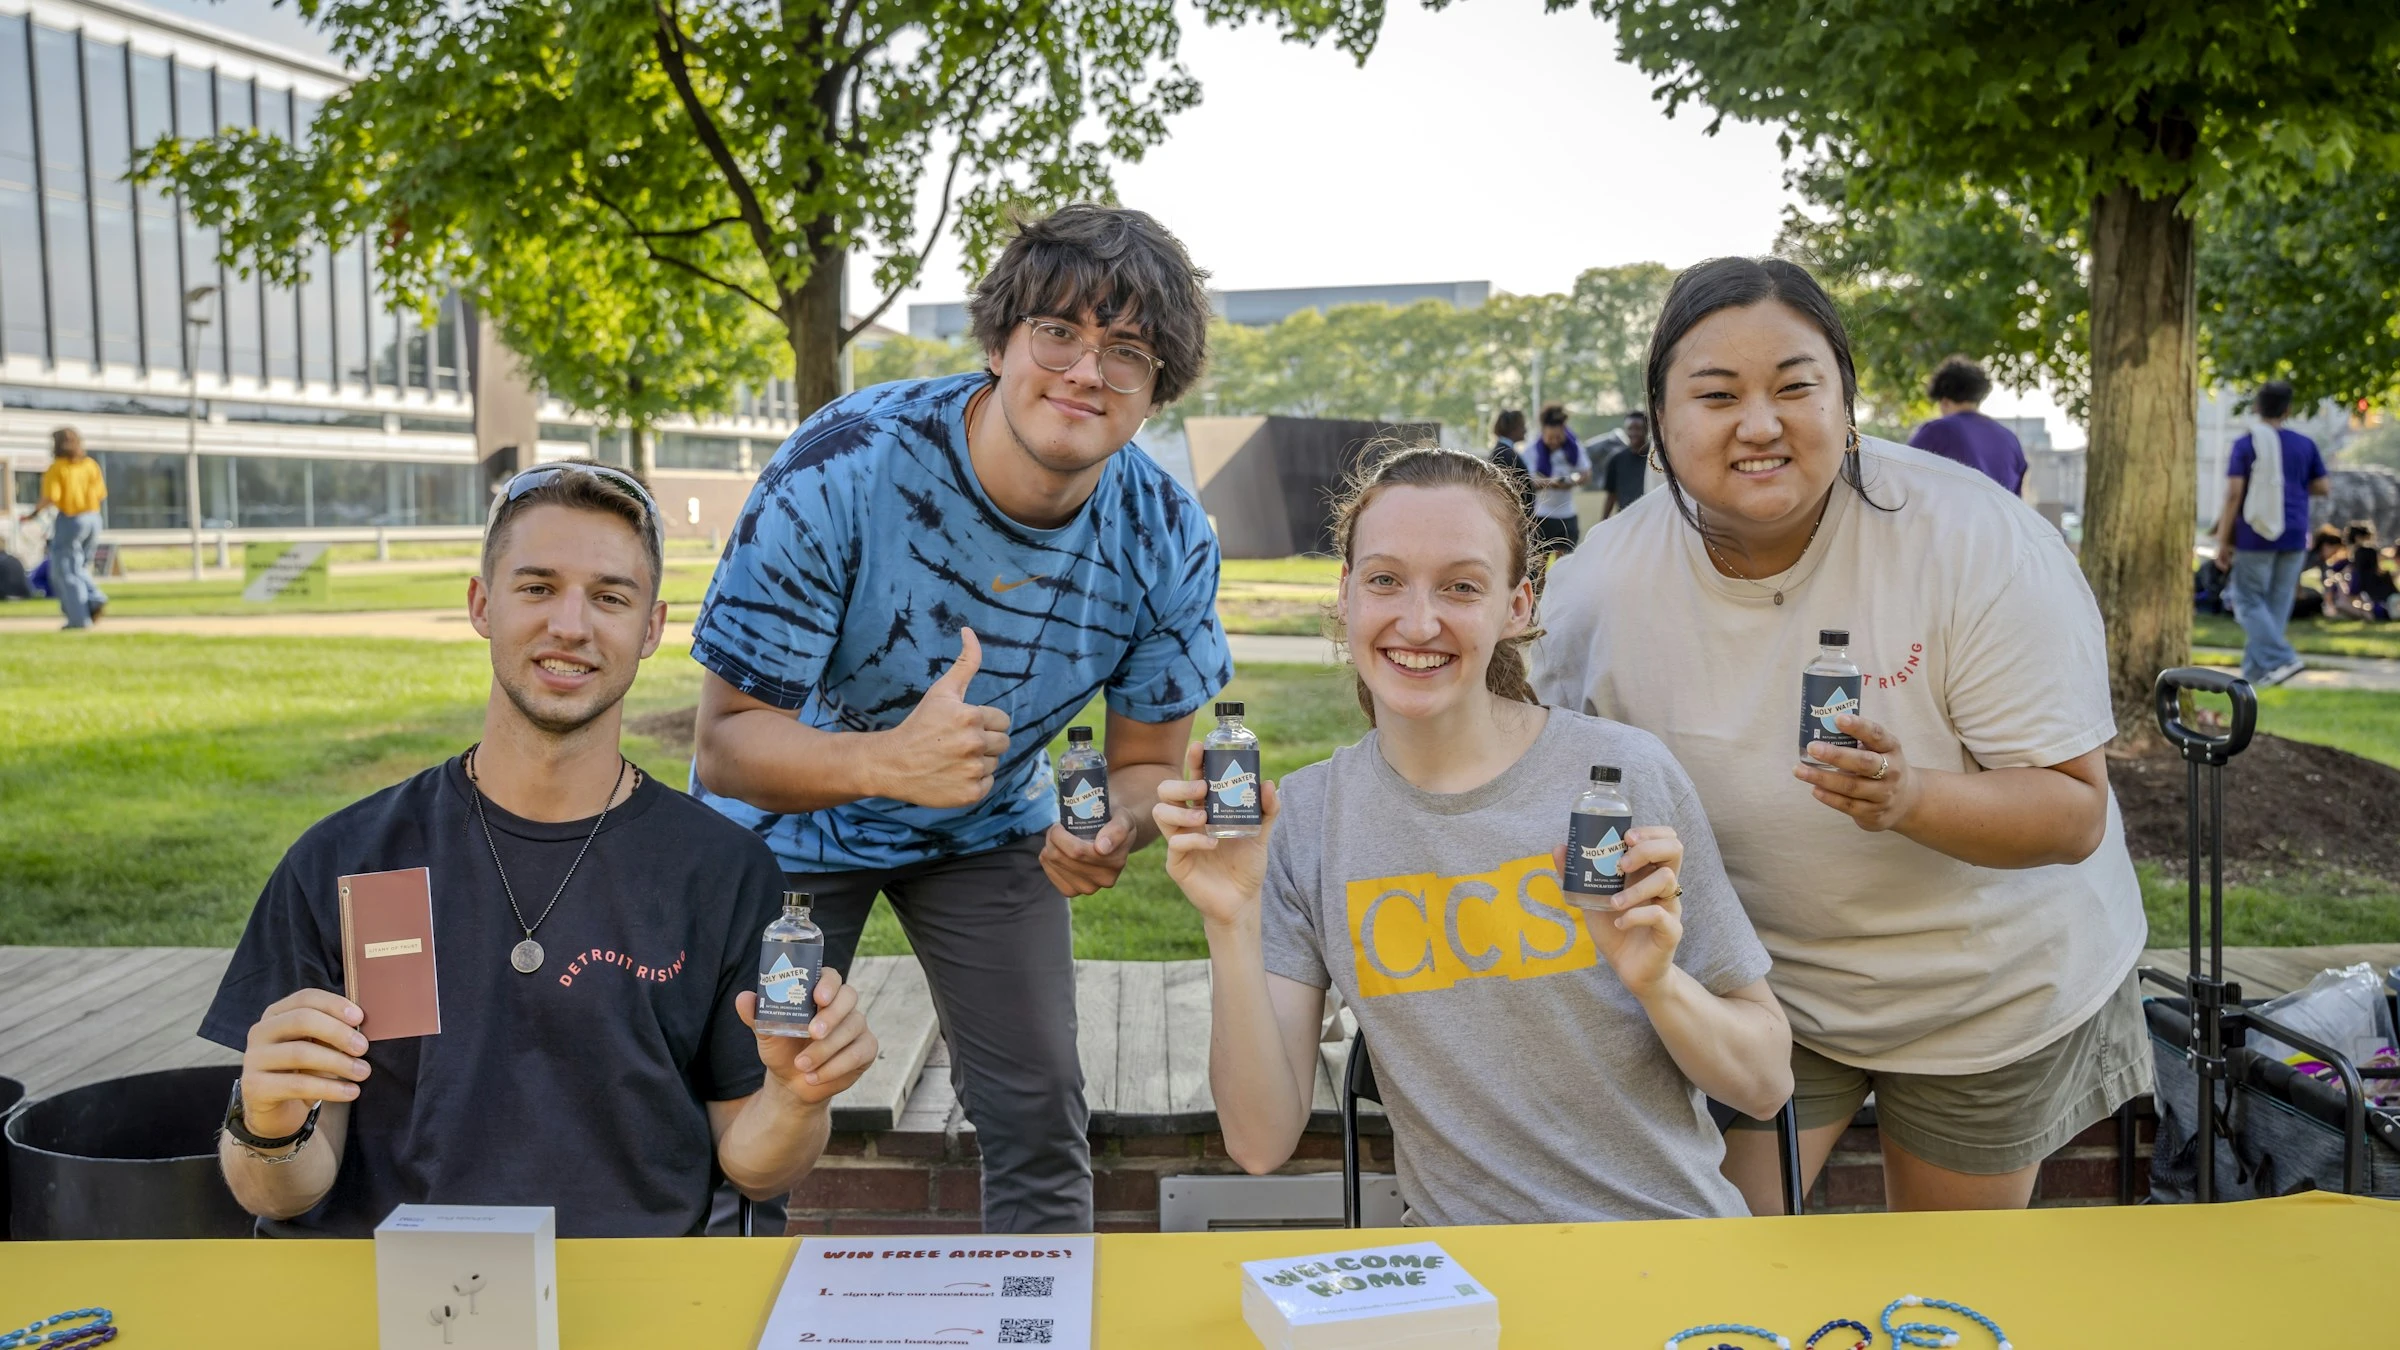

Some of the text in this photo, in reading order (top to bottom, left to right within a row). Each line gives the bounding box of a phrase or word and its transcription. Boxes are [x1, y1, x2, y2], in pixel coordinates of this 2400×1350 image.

[1879, 643, 1922, 689] RISING
[1814, 700, 1856, 716] HOLY WATER
[1212, 774, 1253, 790] HOLY WATER
[1066, 788, 1101, 805] HOLY WATER
[1585, 842, 1626, 857] HOLY WATE
[1360, 868, 1577, 979] CCS
[559, 948, 633, 987] DETROIT
[761, 969, 804, 984] HOLY WATER
[823, 1248, 1073, 1259] WIN FREE AIRPODS!
[1262, 1254, 1444, 1287] WELCOME
[818, 1287, 834, 1296] 1.
[1306, 1270, 1427, 1298] HOME
[799, 1332, 822, 1343] 2.
[904, 1338, 969, 1346] Instagram
